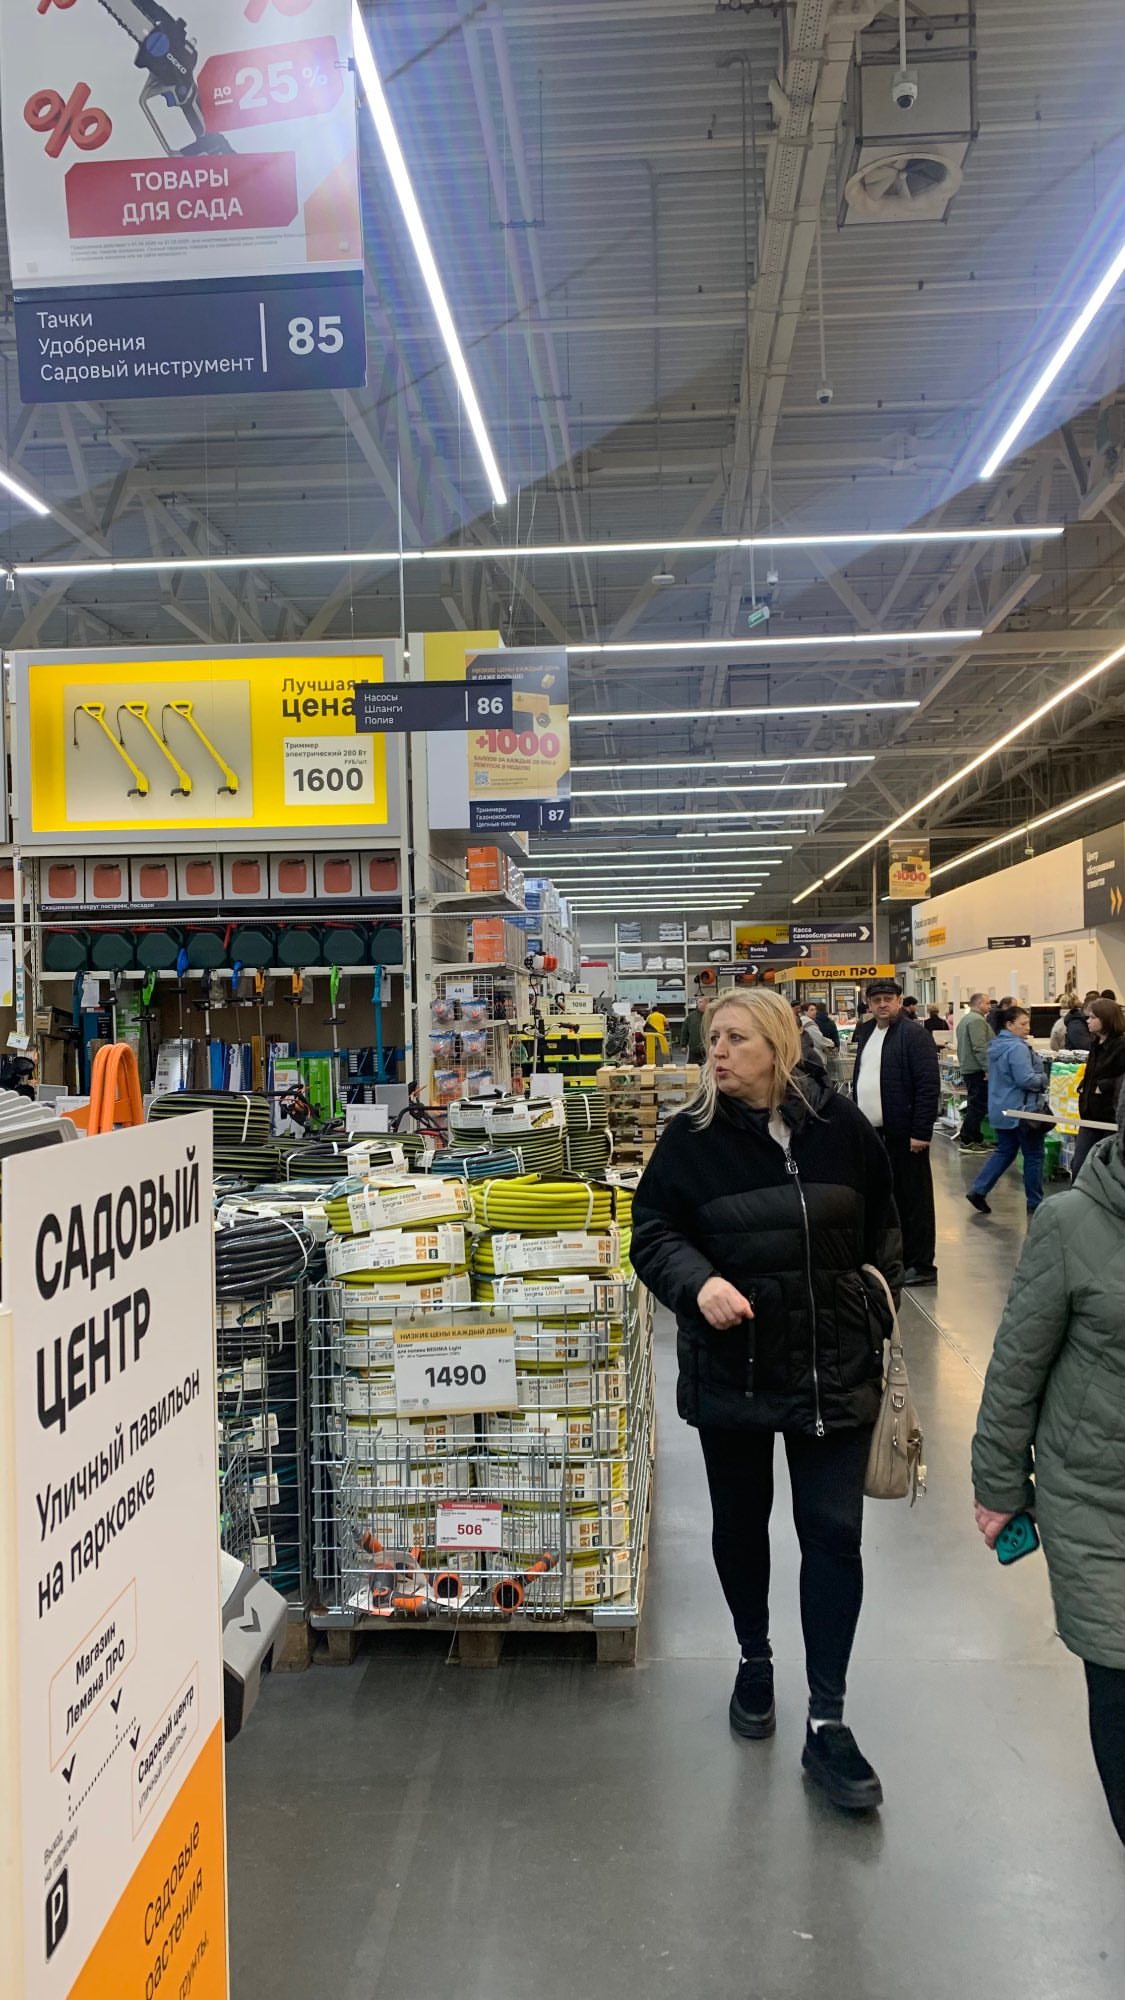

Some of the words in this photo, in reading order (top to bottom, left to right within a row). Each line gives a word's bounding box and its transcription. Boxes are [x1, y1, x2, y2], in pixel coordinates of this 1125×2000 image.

[213, 85, 232, 99] до
[130, 167, 229, 191] ТОВАРЫ
[121, 201, 170, 226] ДЛЯ
[176, 197, 243, 221] САДА
[36, 311, 93, 329] Тачки
[38, 336, 145, 357] Удобрения
[287, 315, 344, 355] 85
[40, 359, 129, 384] Садовый
[134, 356, 255, 378] инструмент
[282, 678, 356, 696] Лучшая
[364, 693, 398, 702] Насосы
[282, 697, 356, 723] цена
[364, 704, 403, 714] Шланги
[477, 696, 504, 715] 86
[364, 715, 394, 725] Полив
[285, 749, 342, 758] электрический
[475, 728, 560, 759] +1000
[293, 767, 363, 792] 1600
[548, 809, 565, 821] 87
[812, 968, 846, 977] Отдел
[850, 967, 877, 976] ПРО
[35, 1145, 200, 1300] САДОВЫЙ
[400, 1332, 429, 1340] НИЗКИЕ
[430, 1330, 451, 1338] ЦЕНЫ
[452, 1328, 485, 1337] КАЖДЫЙ
[37, 1287, 150, 1434] ЦЕНТР
[425, 1364, 487, 1388] 1490
[36, 1421, 124, 1541] Уличный
[130, 1369, 199, 1456] павильон
[457, 1524, 482, 1535] 506
[38, 1560, 64, 1619] на
[70, 1467, 155, 1582] парковке
[76, 1622, 116, 1685] Магазин
[66, 1671, 104, 1734] Лемана
[105, 1639, 125, 1681] ПРО
[138, 1716, 172, 1783] Садовый
[173, 1685, 194, 1727] центр
[144, 1821, 200, 1946] Садовые
[146, 1868, 203, 2000] растения
